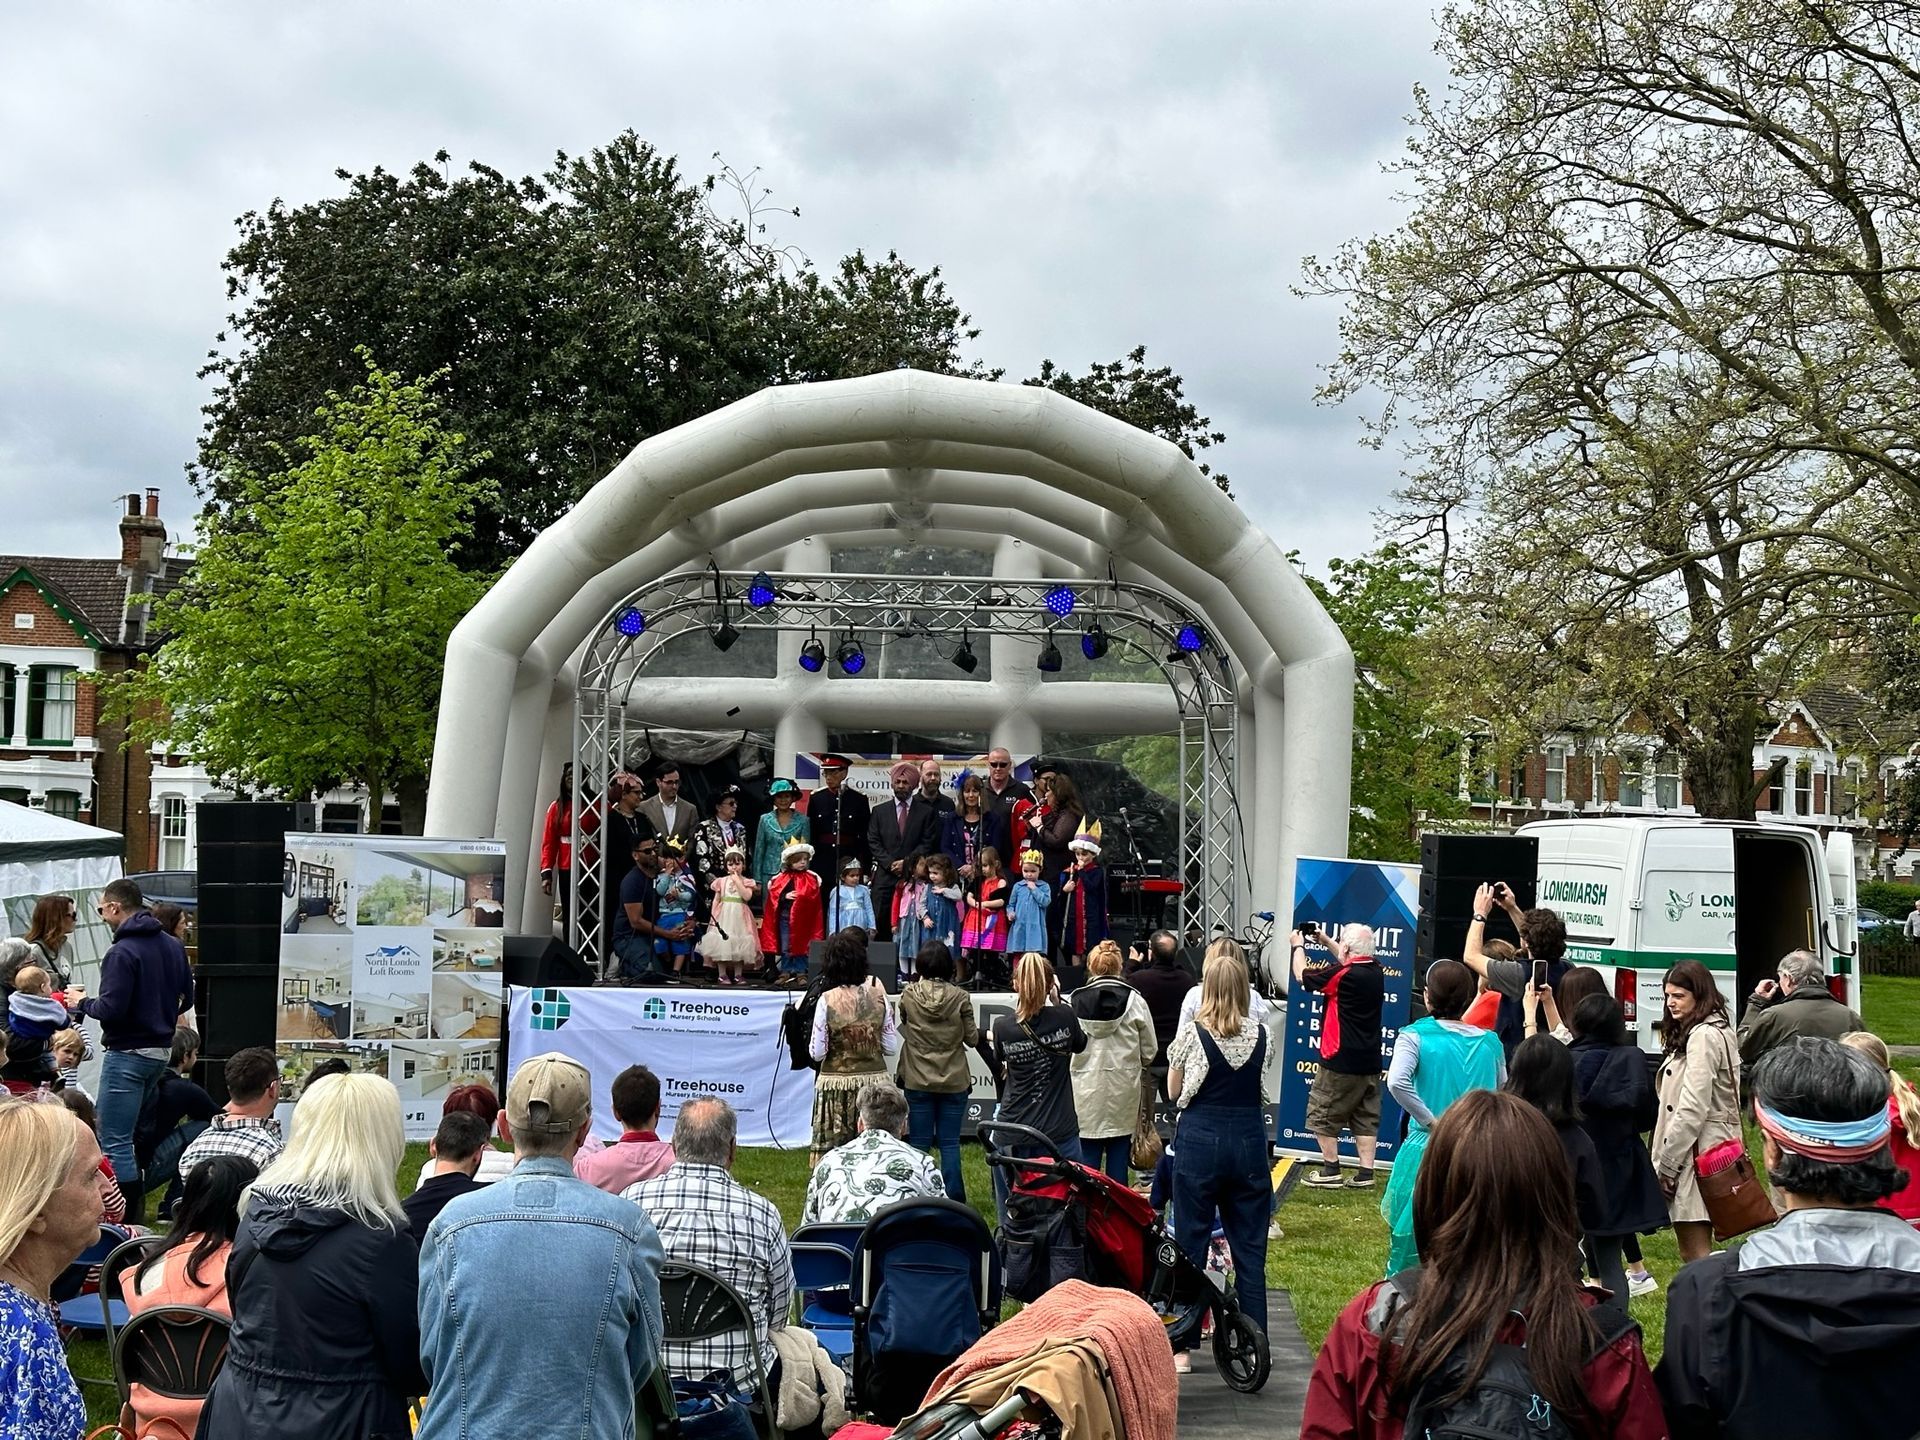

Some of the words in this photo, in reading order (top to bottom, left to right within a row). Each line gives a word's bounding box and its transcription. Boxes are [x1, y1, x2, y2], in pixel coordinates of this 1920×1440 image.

[1543, 880, 1608, 906] LONGMARSH
[1583, 914, 1604, 926] RENTAL
[365, 958, 388, 966] North
[390, 958, 420, 966] London
[370, 967, 386, 975] Loft
[388, 967, 415, 975] Rooms
[671, 1000, 750, 1016] Treehouse
[666, 1078, 745, 1093] Treehouse
[665, 1091, 690, 1099] Nursery
